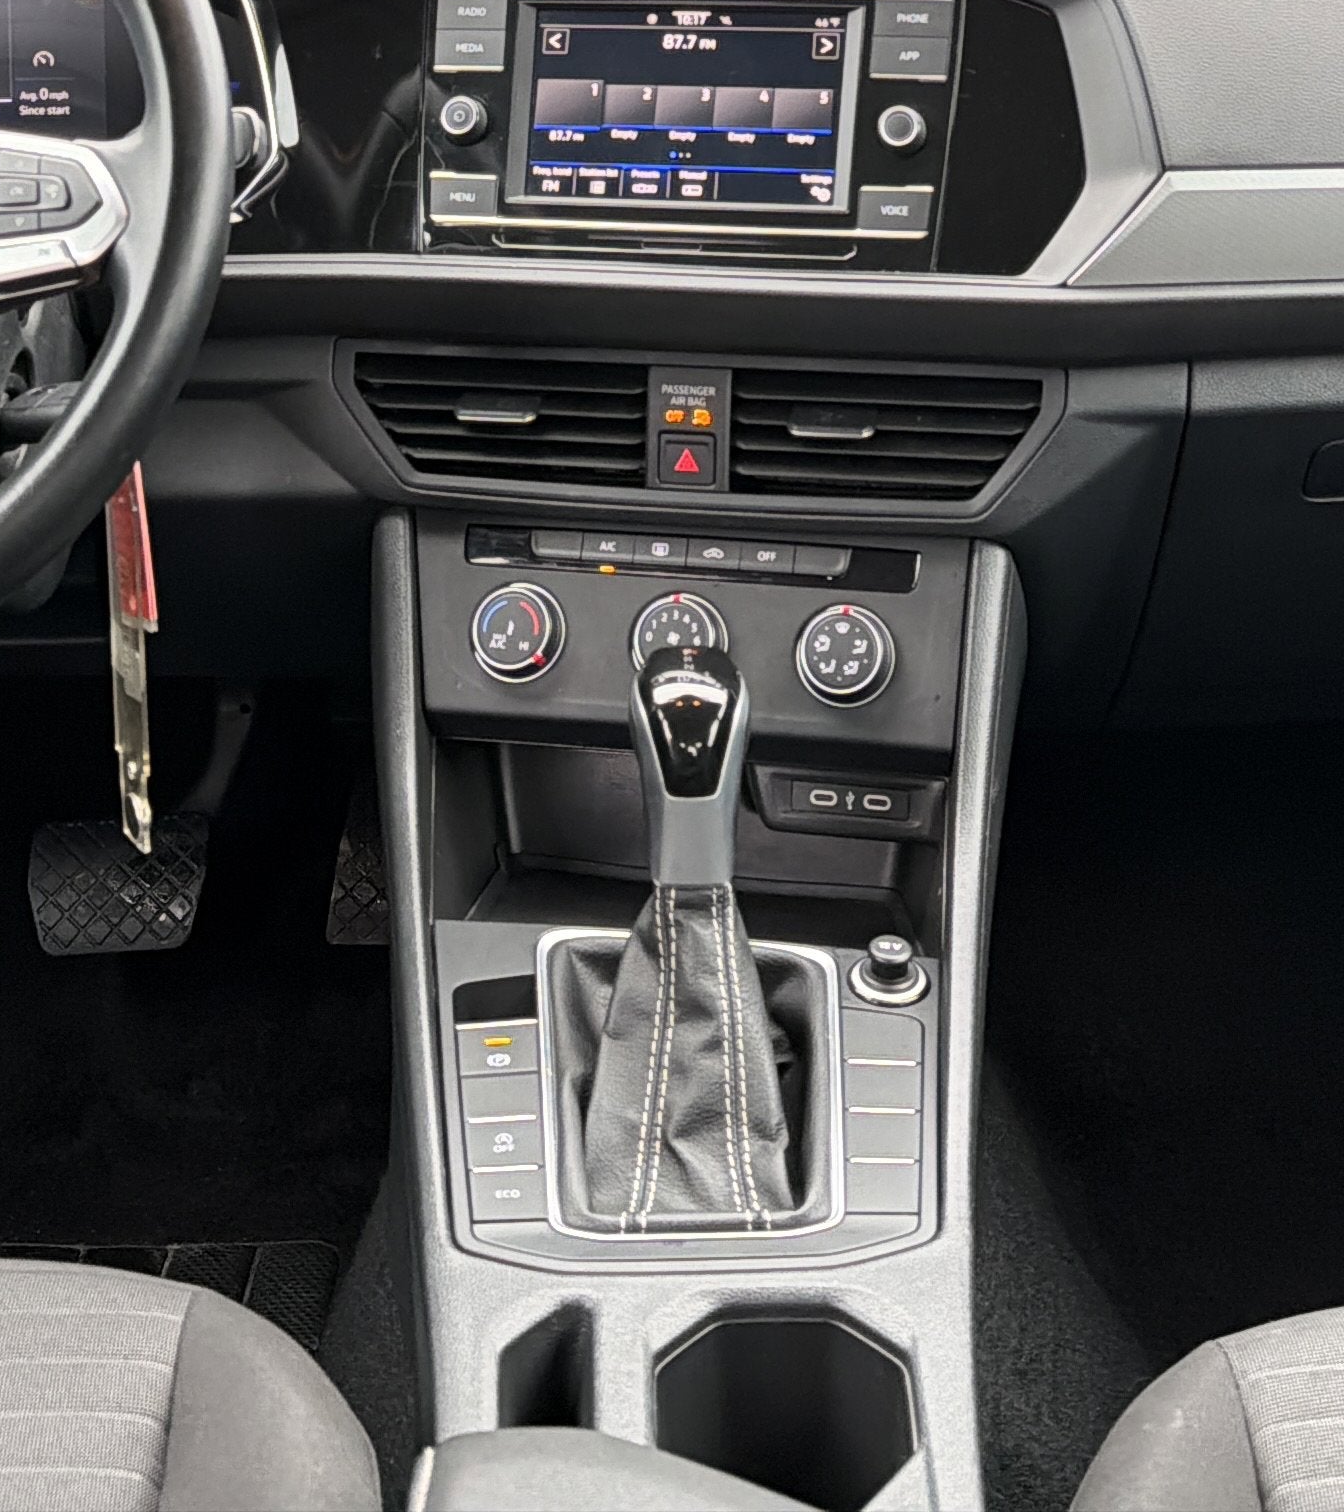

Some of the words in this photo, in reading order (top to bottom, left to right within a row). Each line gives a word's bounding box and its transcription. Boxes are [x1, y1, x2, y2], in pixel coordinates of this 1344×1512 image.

[457, 6, 487, 17] RADIO
[896, 12, 929, 24] PHONE
[662, 33, 698, 50] 87.7
[698, 38, 717, 51] FM
[455, 43, 485, 54] MEDIA
[899, 50, 921, 61] APP
[39, 87, 49, 101] 0
[49, 90, 69, 102] mph
[590, 82, 599, 96] 1
[642, 86, 653, 100] 2
[700, 88, 711, 102] 3
[759, 90, 770, 103] 4
[819, 91, 829, 104] 5
[18, 104, 46, 116] Since
[46, 105, 71, 116] start
[541, 179, 561, 193] FM
[449, 192, 476, 203] MENU
[880, 205, 910, 217] VOICE
[661, 384, 717, 397] PASSENGER
[670, 396, 686, 406] AIR
[687, 396, 707, 407] BAG
[598, 541, 617, 552] A/C
[756, 550, 777, 562] OFF
[660, 611, 668, 623] 2
[672, 609, 680, 621] 3
[682, 614, 691, 624] 4
[652, 619, 657, 630] 1
[690, 622, 698, 634] 5
[645, 631, 654, 642] 0
[692, 635, 702, 647] 6
[518, 641, 530, 651] HI
[492, 1143, 516, 1154] OFF
[494, 1189, 521, 1199] ECO
